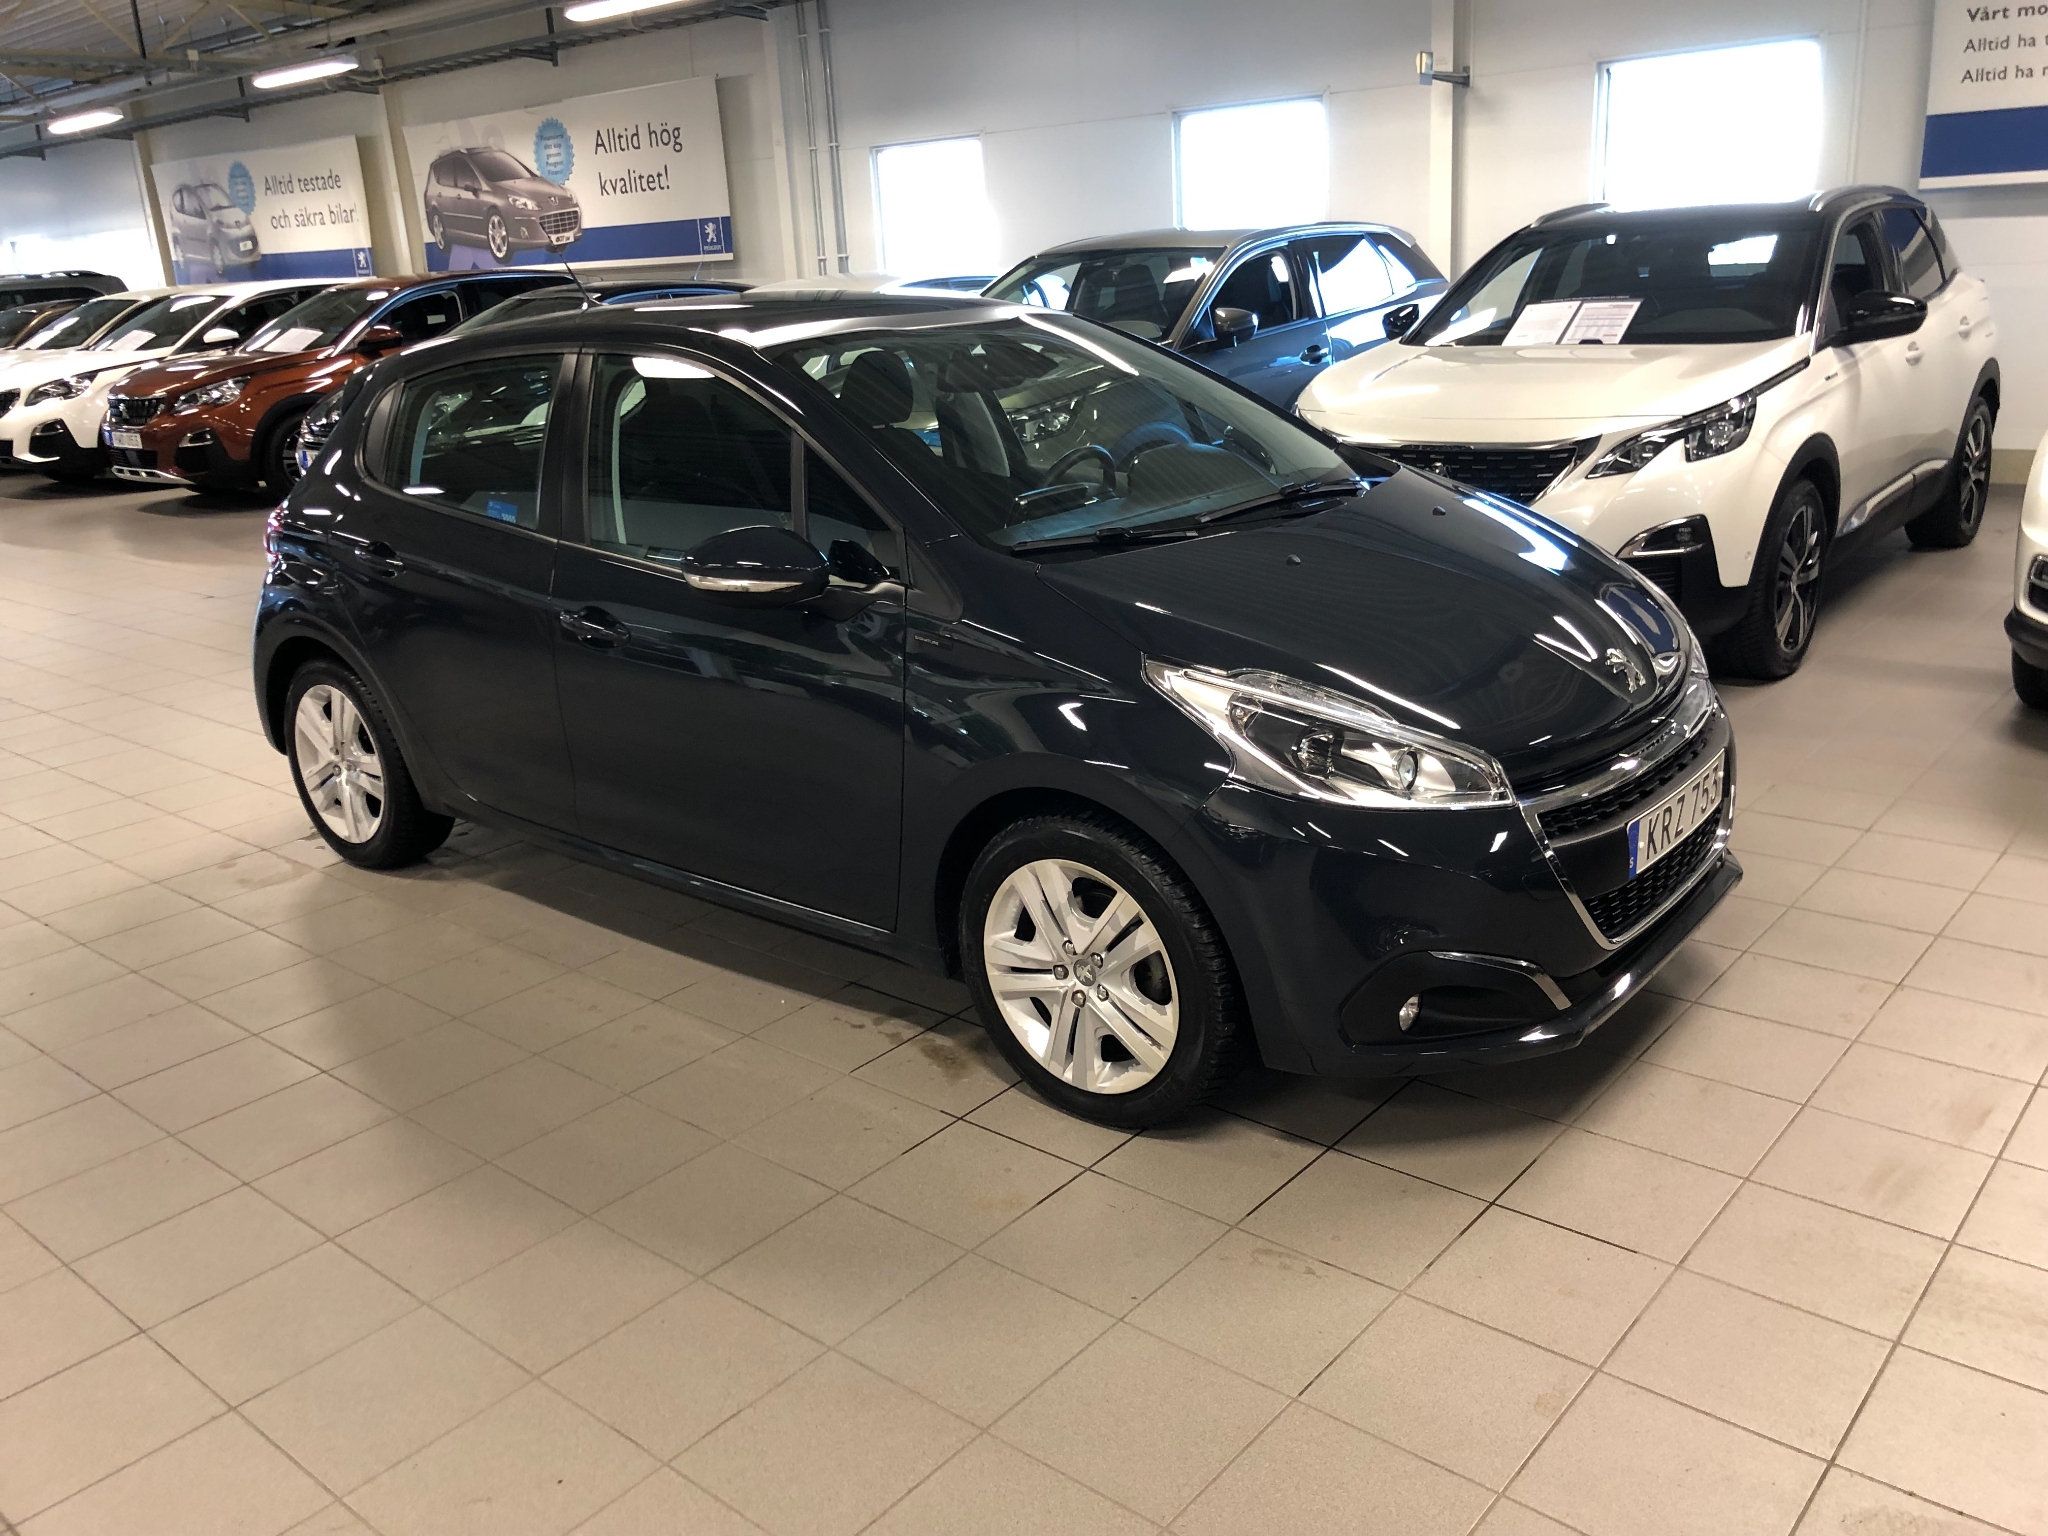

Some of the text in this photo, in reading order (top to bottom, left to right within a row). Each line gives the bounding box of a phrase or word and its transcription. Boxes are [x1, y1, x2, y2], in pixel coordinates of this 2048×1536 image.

[1967, 6, 2010, 22] Vårt
[1963, 35, 2010, 53] Alltid
[2018, 34, 2036, 48] ha
[1961, 66, 2007, 83] Alltid
[2015, 65, 2033, 79] ha
[595, 122, 683, 155] Alltid hög
[264, 173, 295, 196] Alltid
[297, 168, 342, 193] testade
[598, 164, 670, 196] kvalitet!
[270, 208, 292, 229] och
[294, 206, 326, 228] säkra
[1646, 762, 1718, 860] KRZ 753
